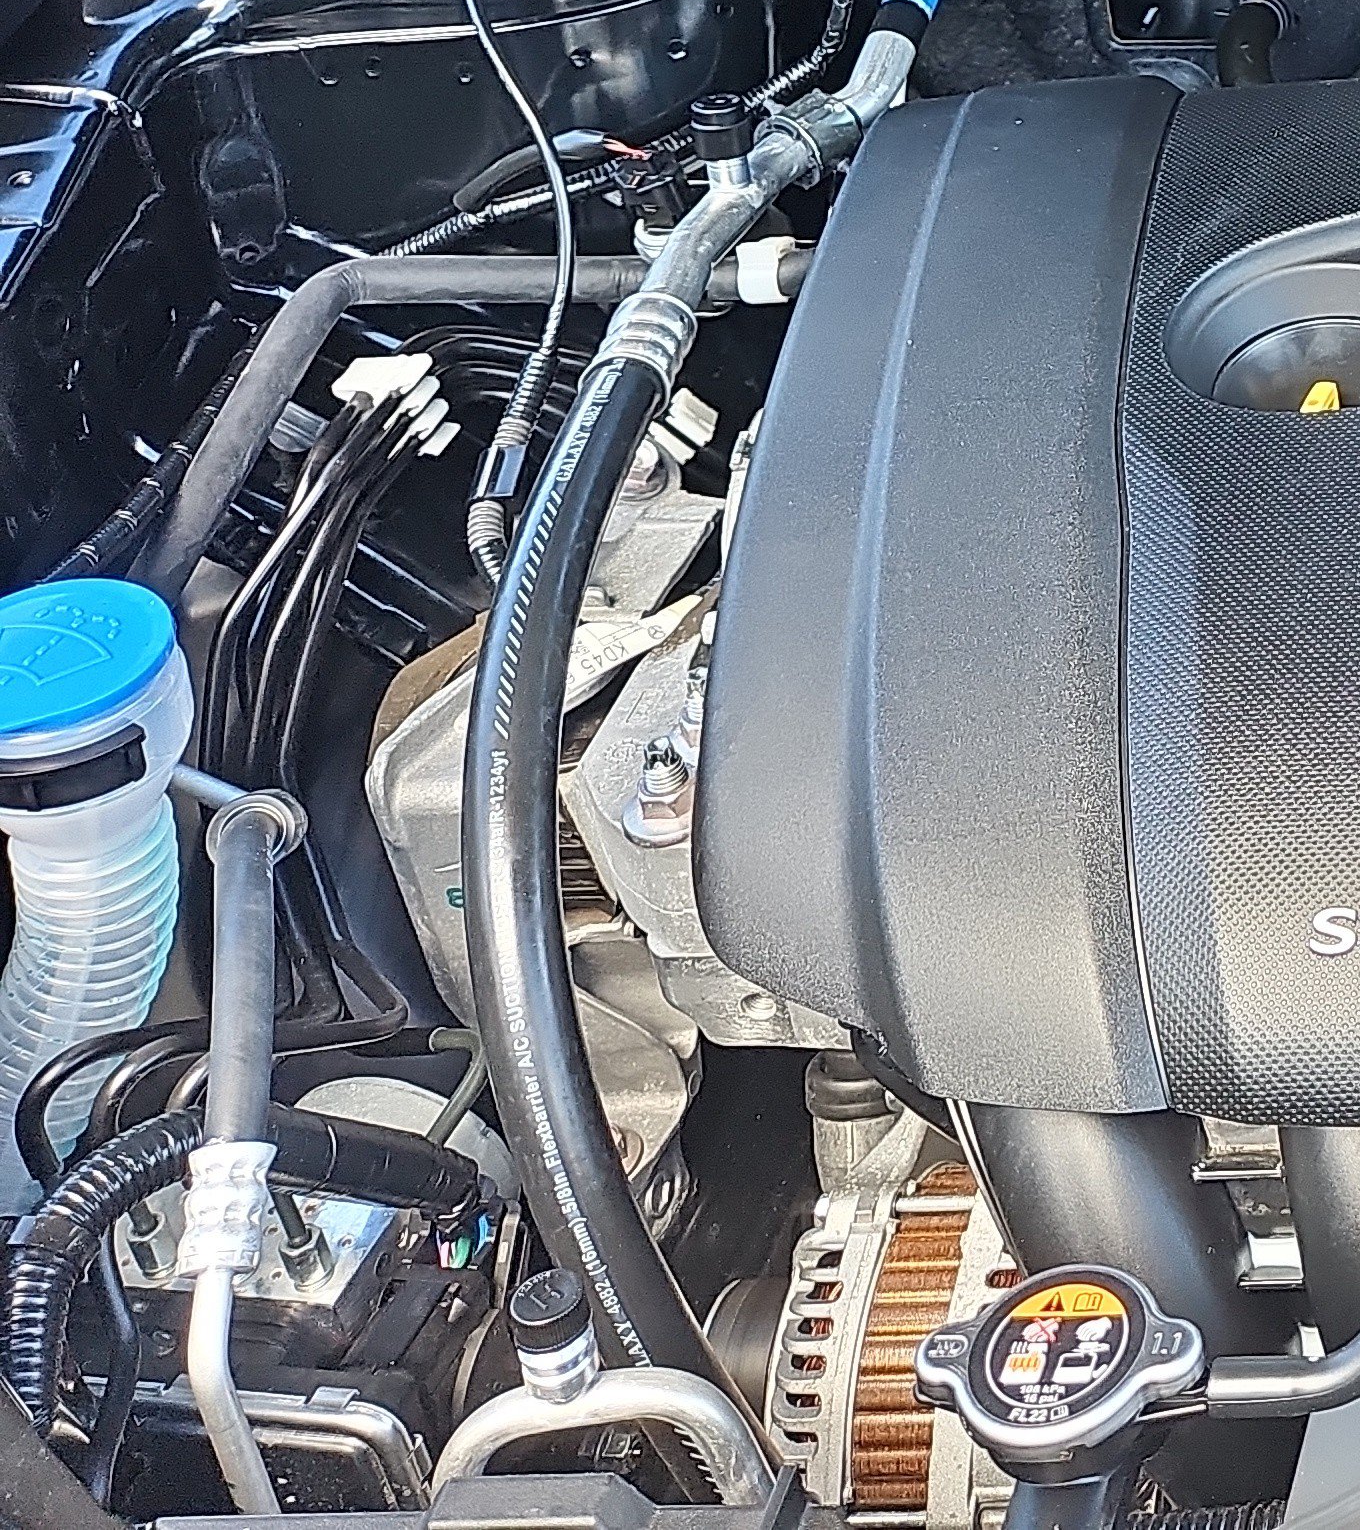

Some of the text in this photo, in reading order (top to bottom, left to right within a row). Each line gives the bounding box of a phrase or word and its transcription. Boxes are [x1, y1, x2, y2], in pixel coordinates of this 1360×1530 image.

[555, 430, 591, 483] GALAXY
[580, 641, 629, 675] KD45
[498, 947, 527, 1034] SUCTION
[513, 1036, 536, 1069] A/C
[524, 1074, 563, 1170] Flexbarrier
[567, 1216, 609, 1277] (16mm)
[594, 1278, 622, 1316] 4882
[613, 1320, 654, 1367] LAXY
[1151, 1331, 1183, 1355] 1.1
[1009, 1406, 1049, 1422] FL22
